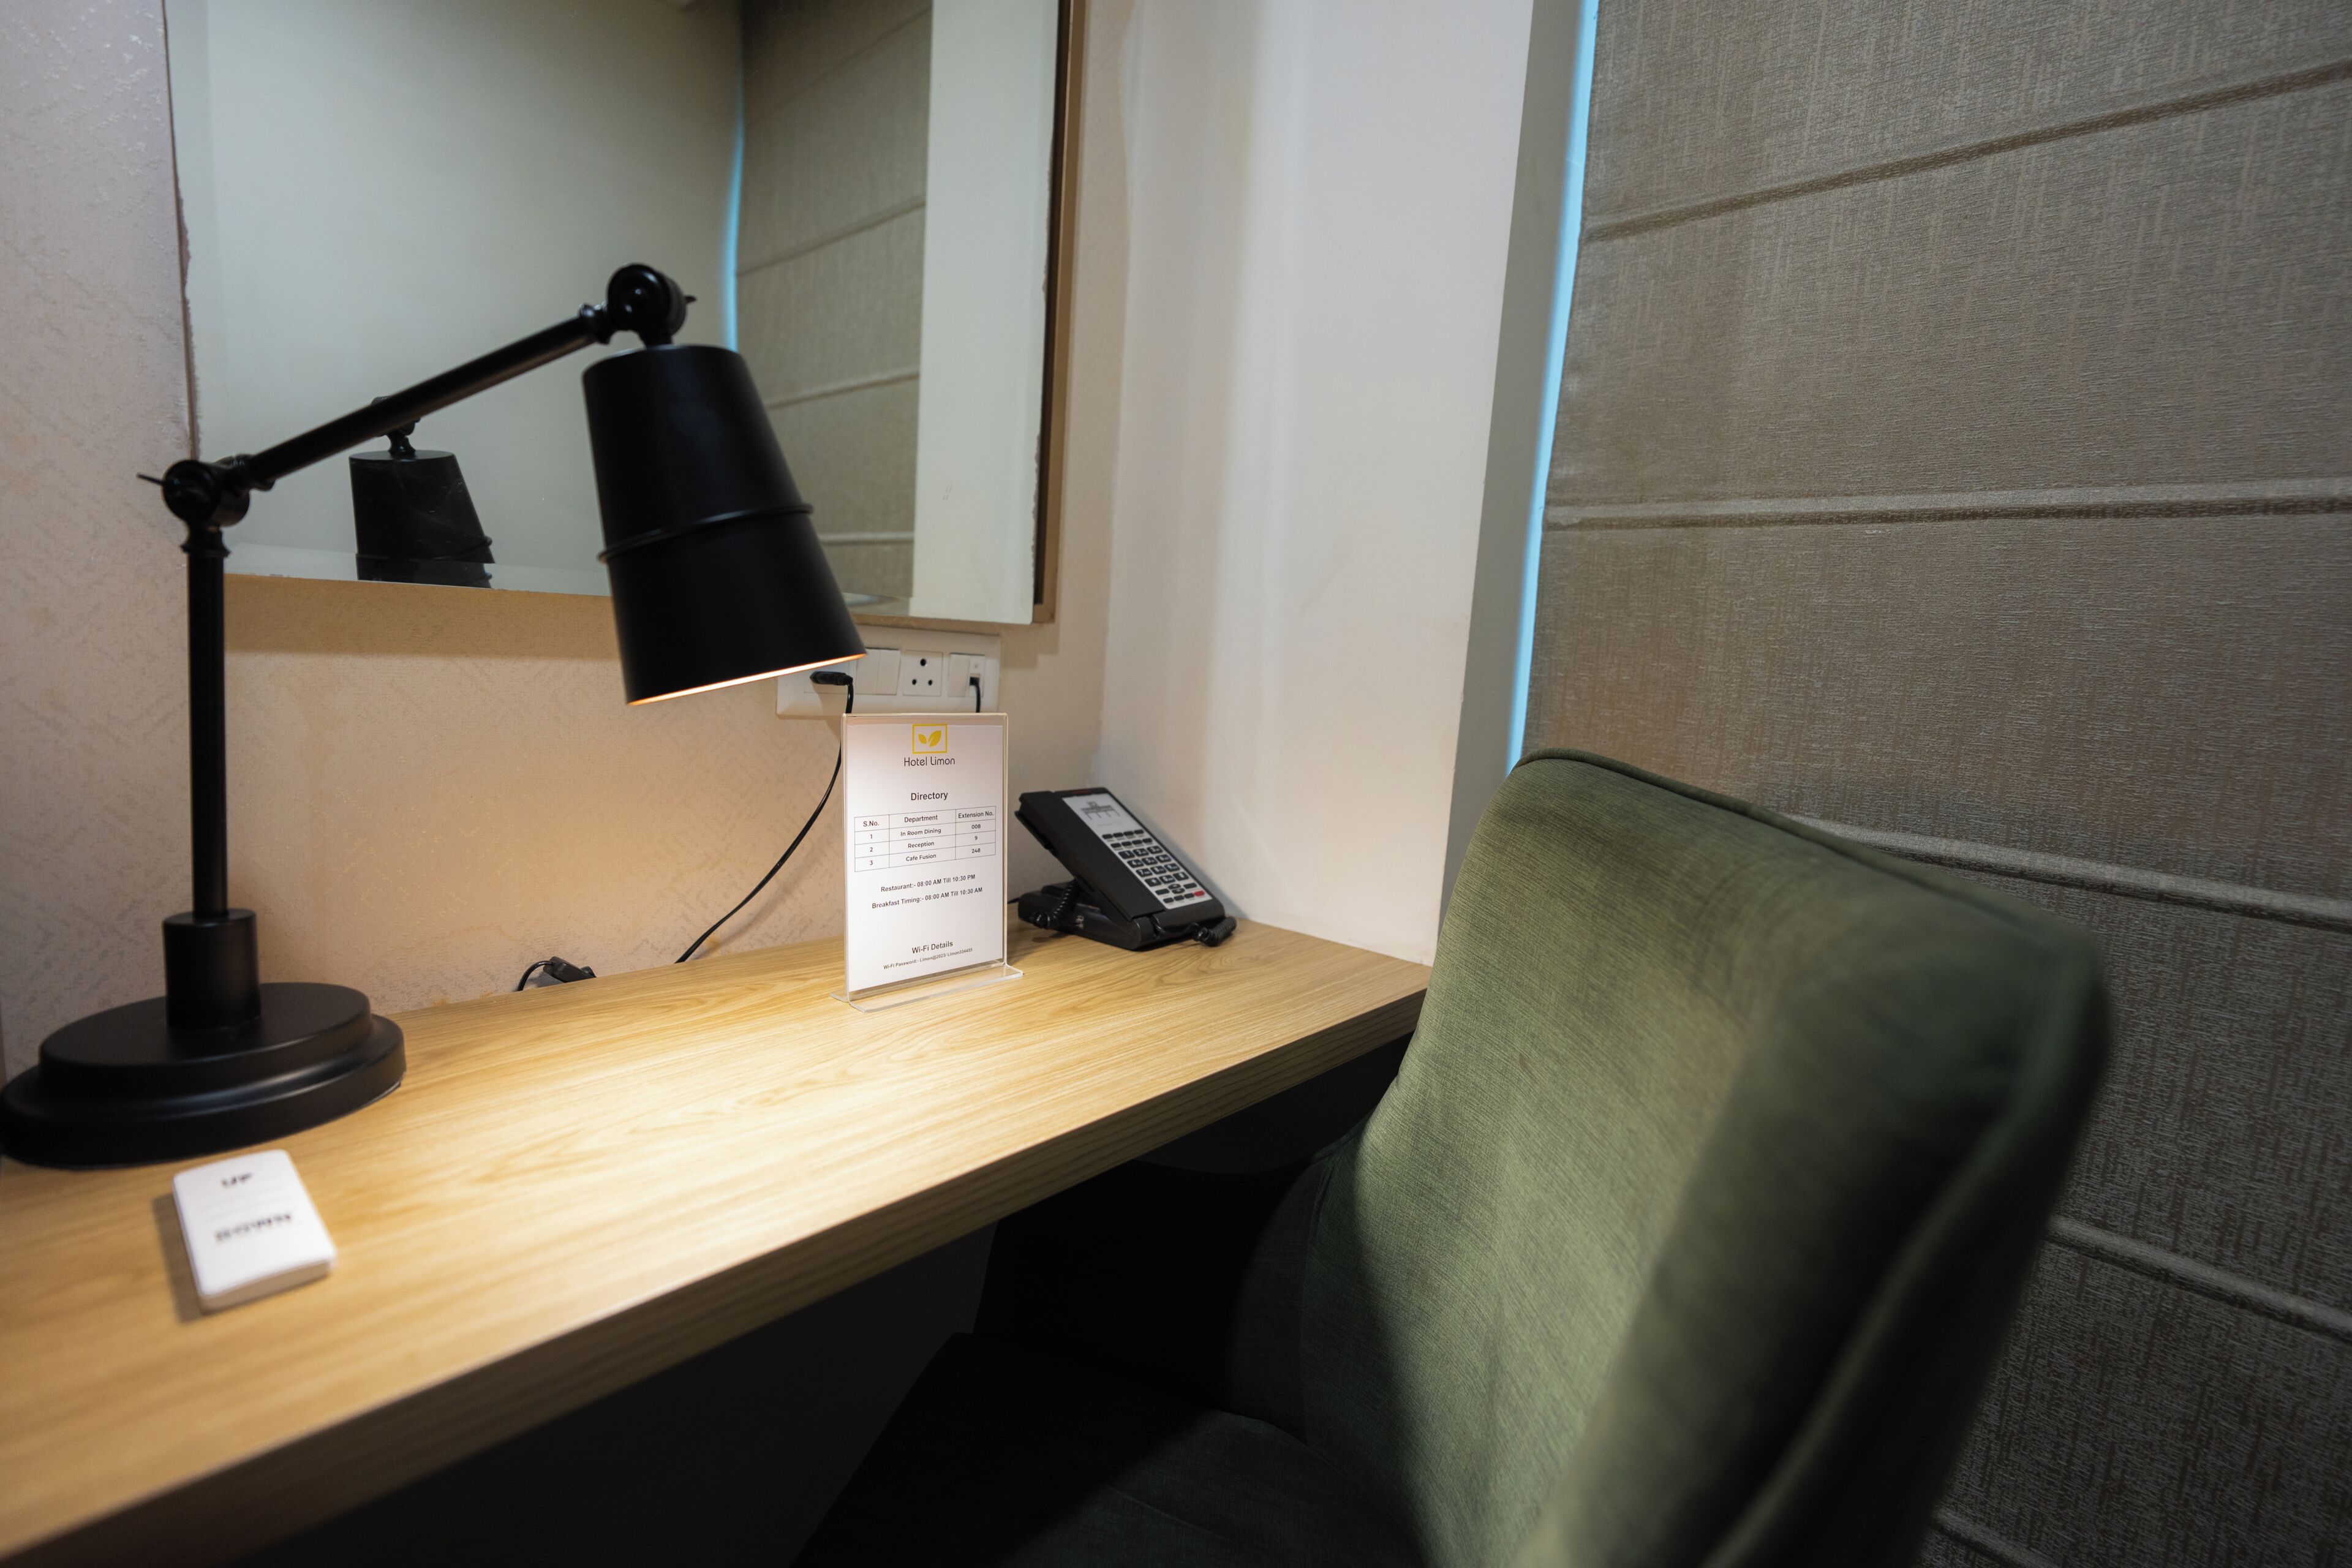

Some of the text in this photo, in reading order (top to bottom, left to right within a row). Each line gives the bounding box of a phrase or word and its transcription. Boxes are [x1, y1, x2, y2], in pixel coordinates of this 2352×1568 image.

[904, 756, 955, 767] Hotel Limon
[911, 792, 948, 801] Directory
[881, 883, 916, 892] Restaurant:-
[872, 900, 899, 909] Breakfast
[912, 941, 953, 954] Wi-Fi Details
